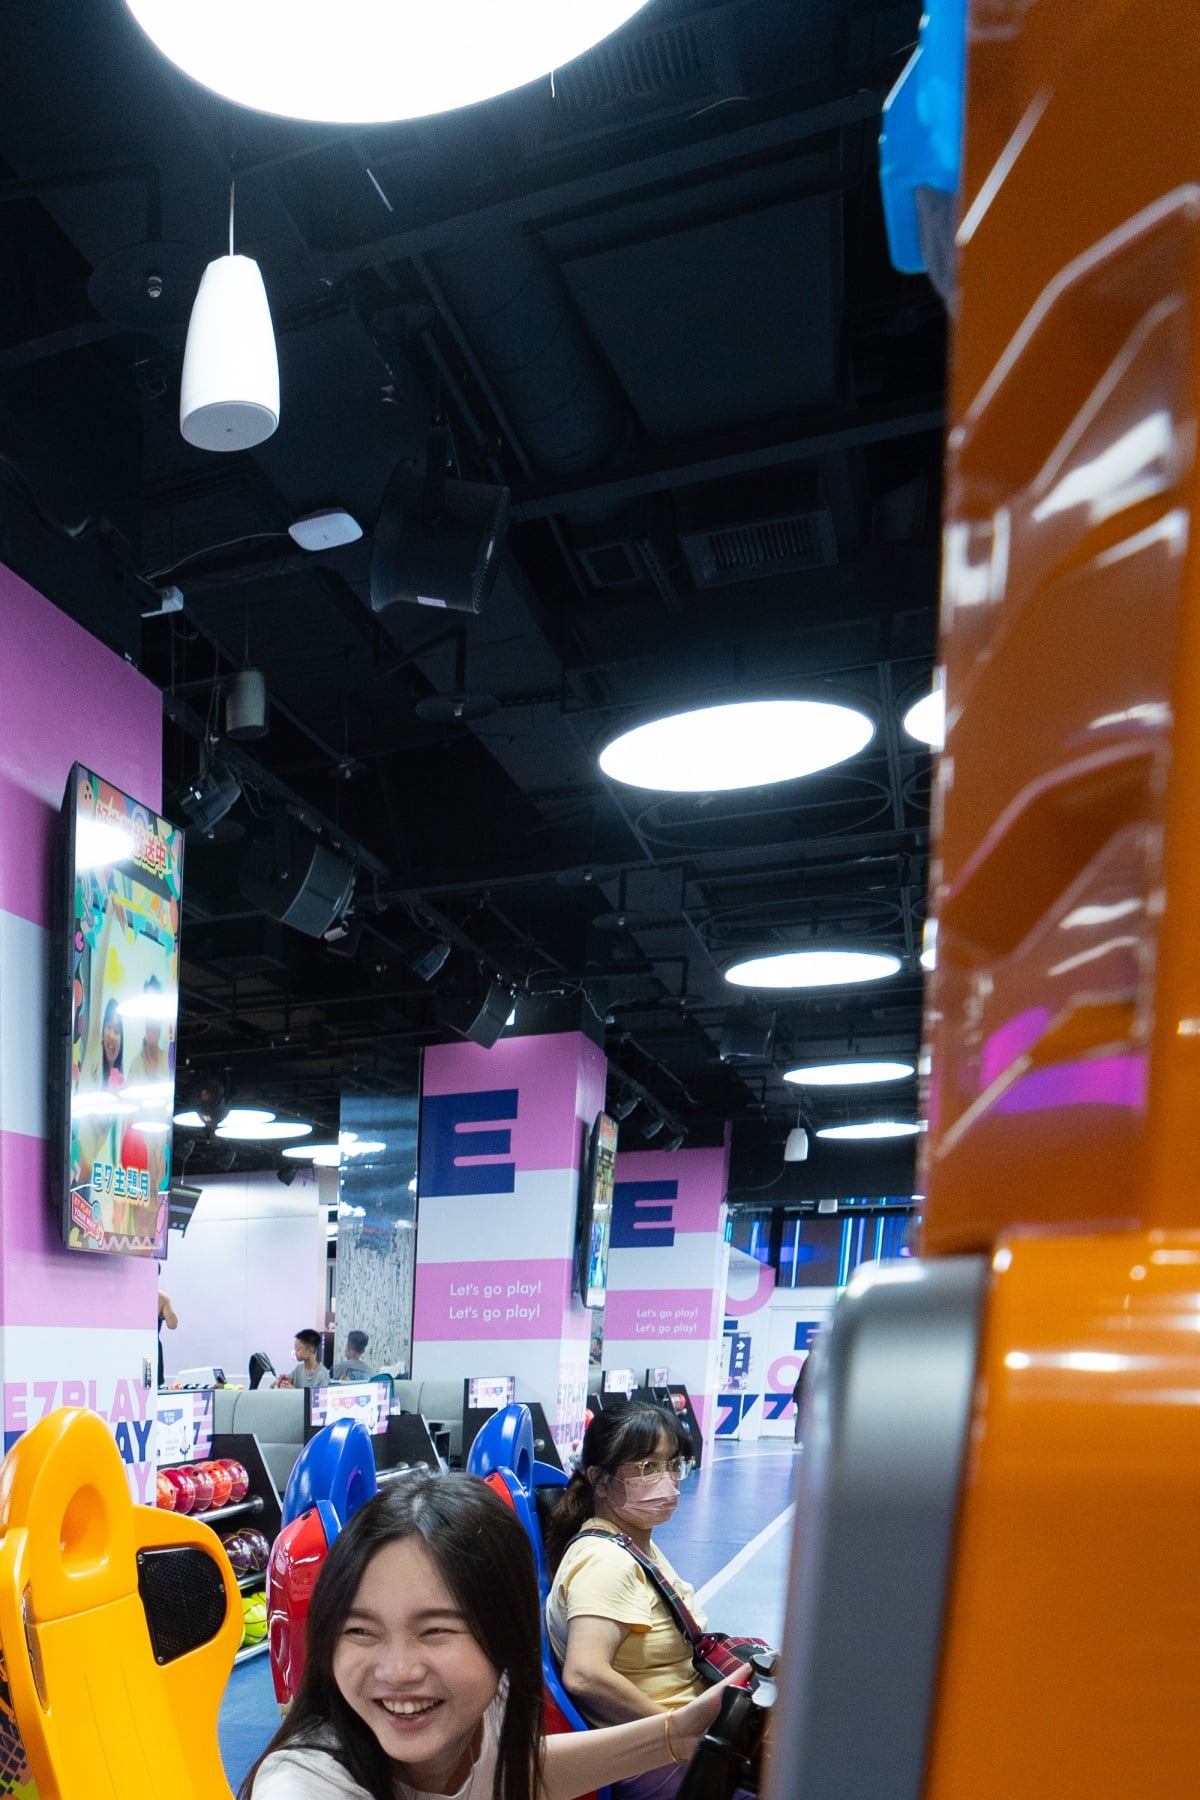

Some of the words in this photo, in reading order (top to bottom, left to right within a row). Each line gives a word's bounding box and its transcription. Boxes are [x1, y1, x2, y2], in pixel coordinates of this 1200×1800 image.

[421, 1089, 518, 1197] E
[450, 1283, 479, 1296] Let's
[484, 1285, 502, 1298] go
[507, 1280, 541, 1298] play!
[449, 1306, 478, 1319] Let's
[483, 1308, 501, 1321] go
[506, 1303, 540, 1320] play!
[660, 1310, 672, 1319] go
[659, 1325, 671, 1334] go
